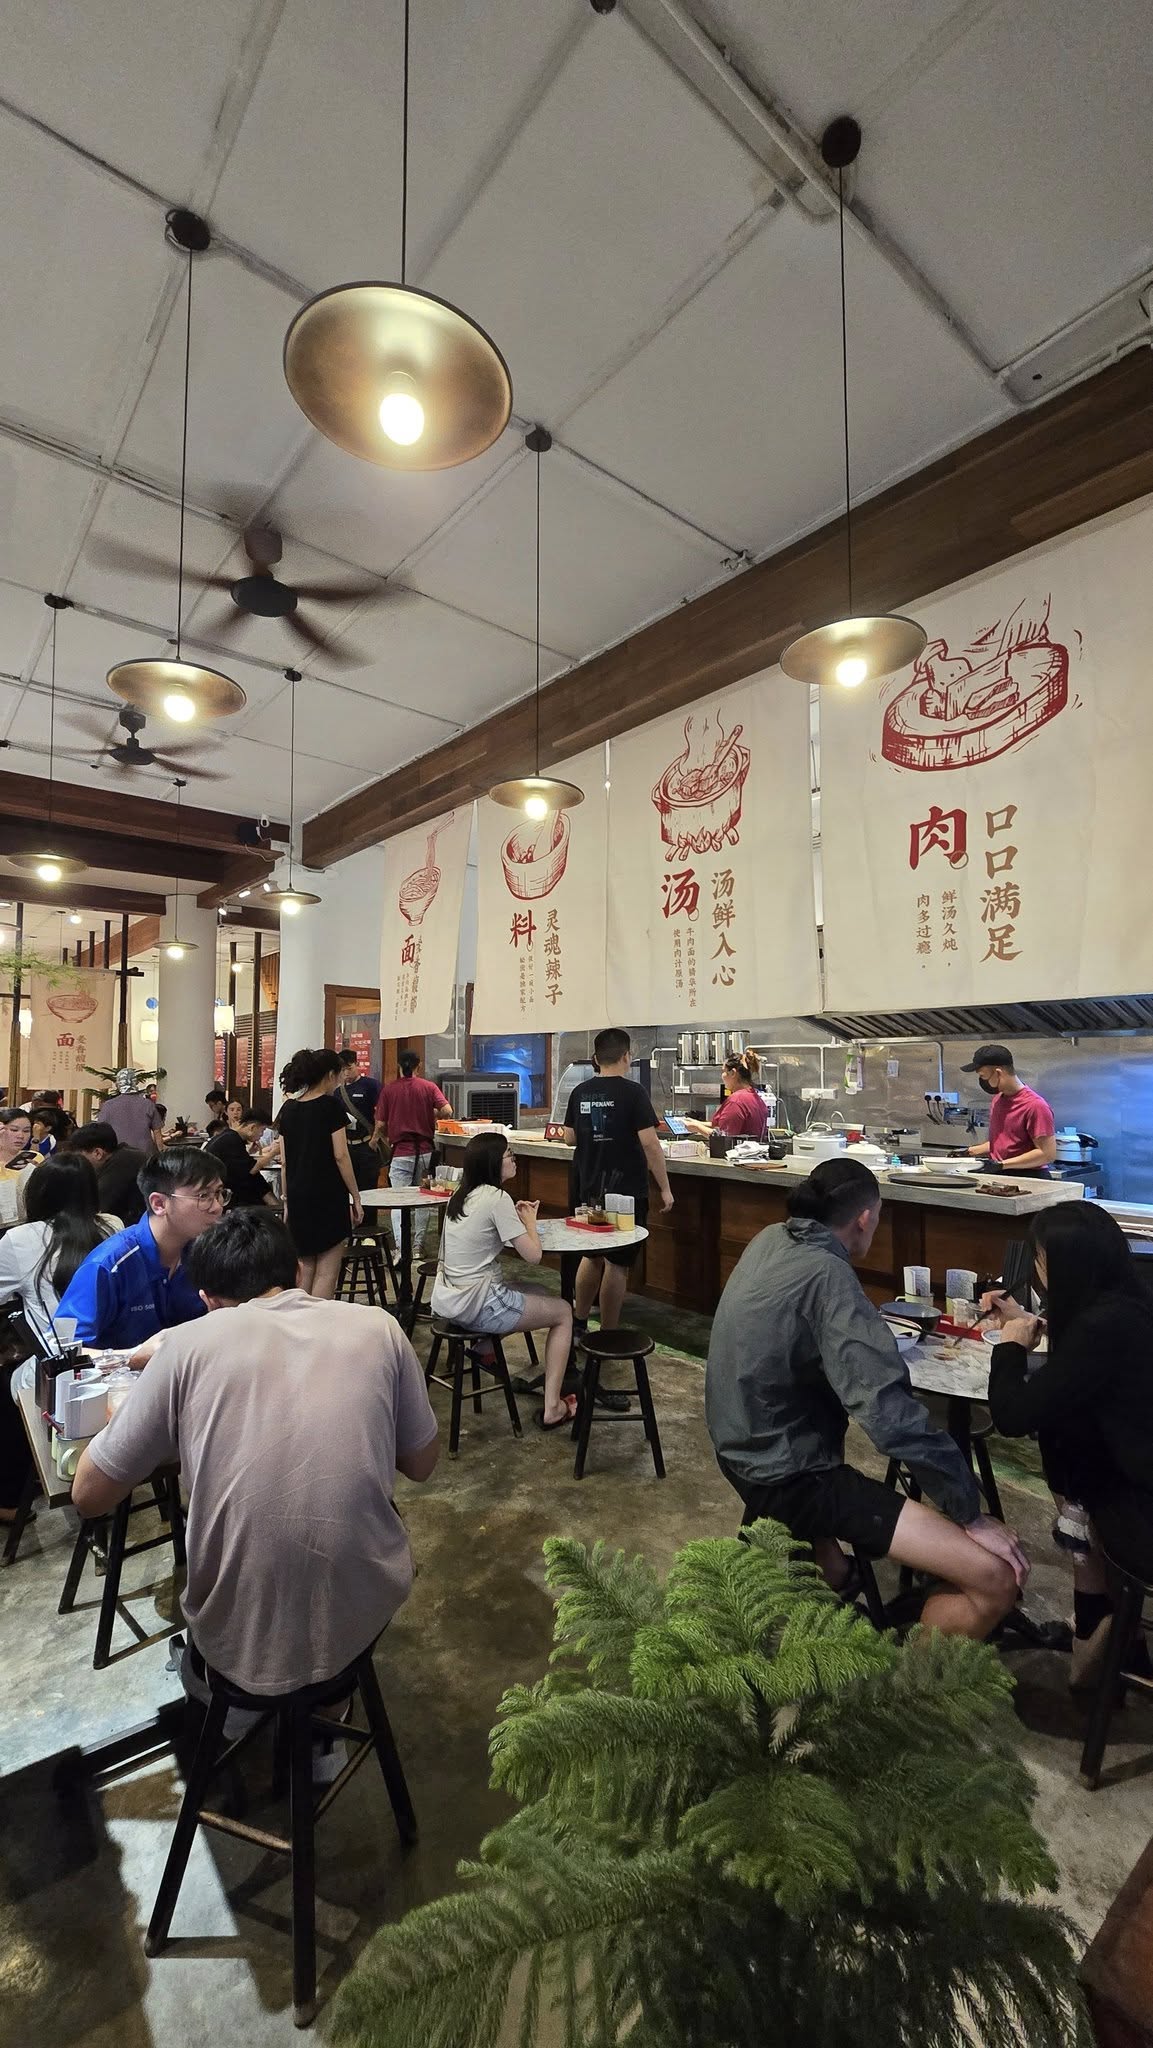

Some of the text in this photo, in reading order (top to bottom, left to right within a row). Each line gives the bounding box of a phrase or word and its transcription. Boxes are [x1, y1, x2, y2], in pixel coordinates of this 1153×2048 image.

[909, 806, 969, 870] 肉
[660, 868, 701, 919] 汤
[979, 804, 1024, 963] 口口满足
[401, 934, 416, 966] 面
[509, 909, 537, 948] 料
[710, 868, 737, 987] 汤鲜入心
[544, 908, 563, 1006] 灵魂辣子
[56, 1032, 74, 1046] 面
